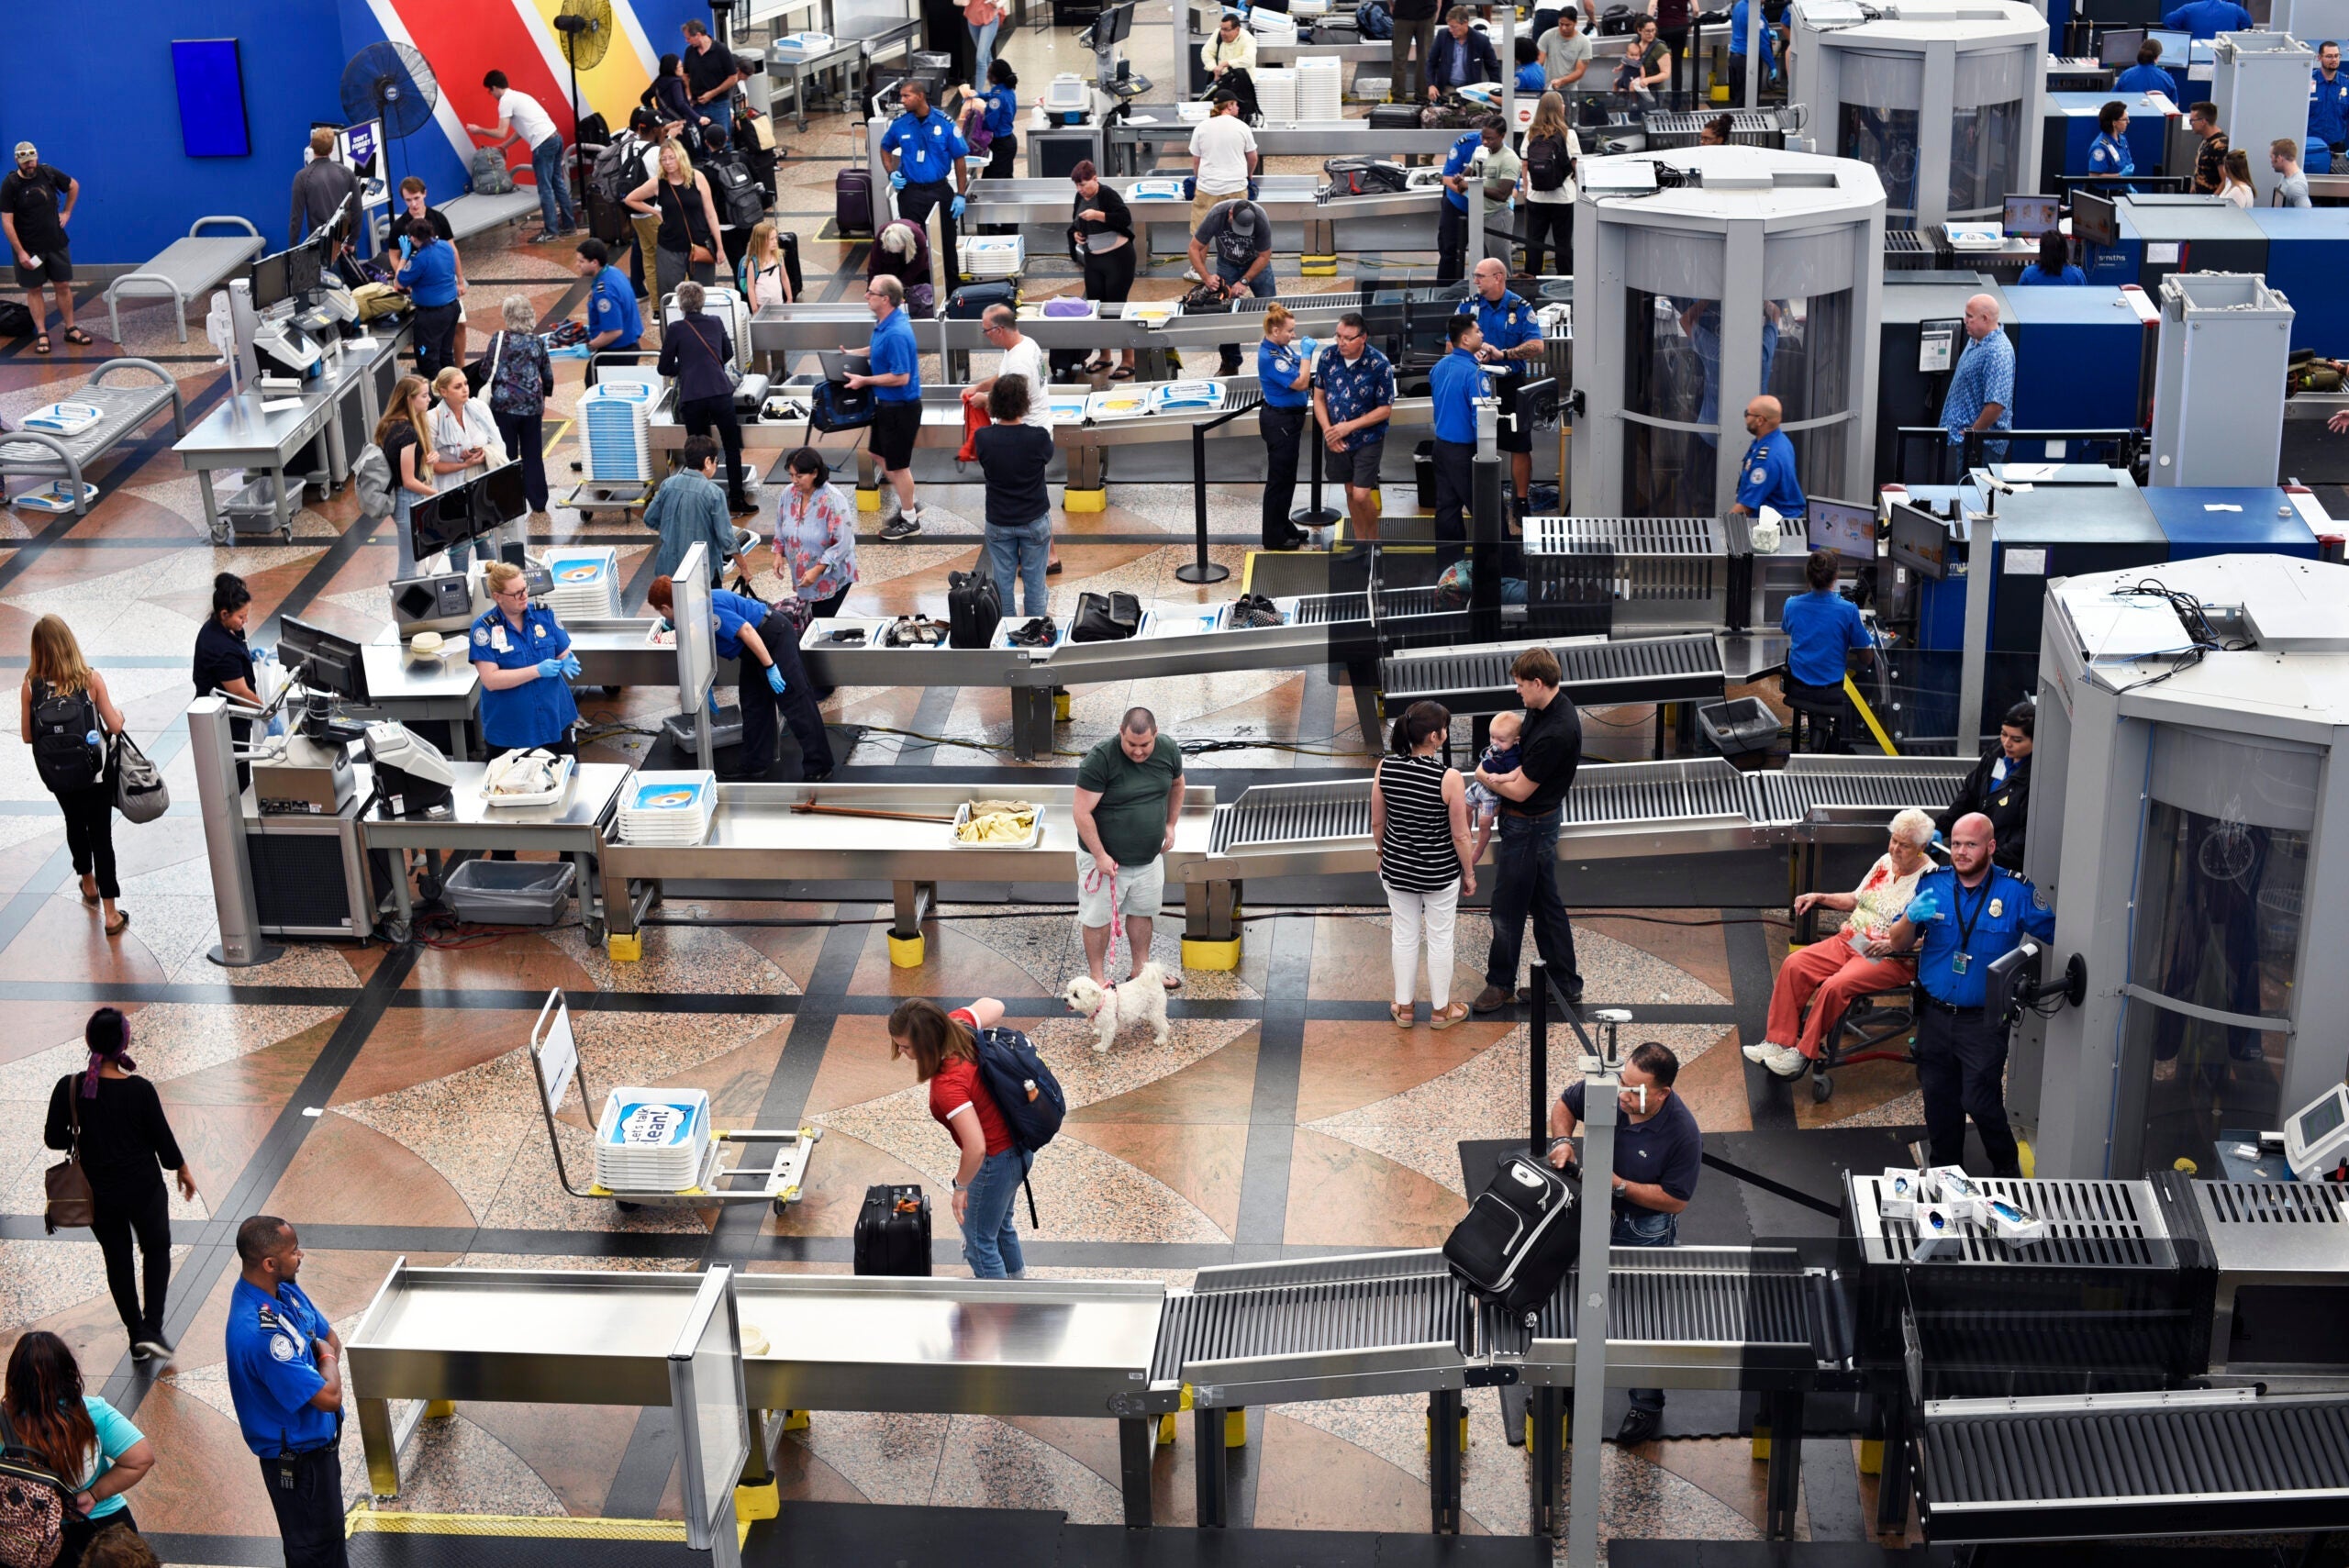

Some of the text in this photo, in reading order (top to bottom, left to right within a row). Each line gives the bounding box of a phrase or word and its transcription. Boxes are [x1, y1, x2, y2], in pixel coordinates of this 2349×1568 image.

[352, 133, 368, 143] DON'T
[351, 139, 371, 150] FORGET
[636, 1108, 650, 1122] talk
[640, 1111, 669, 1145] lean!
